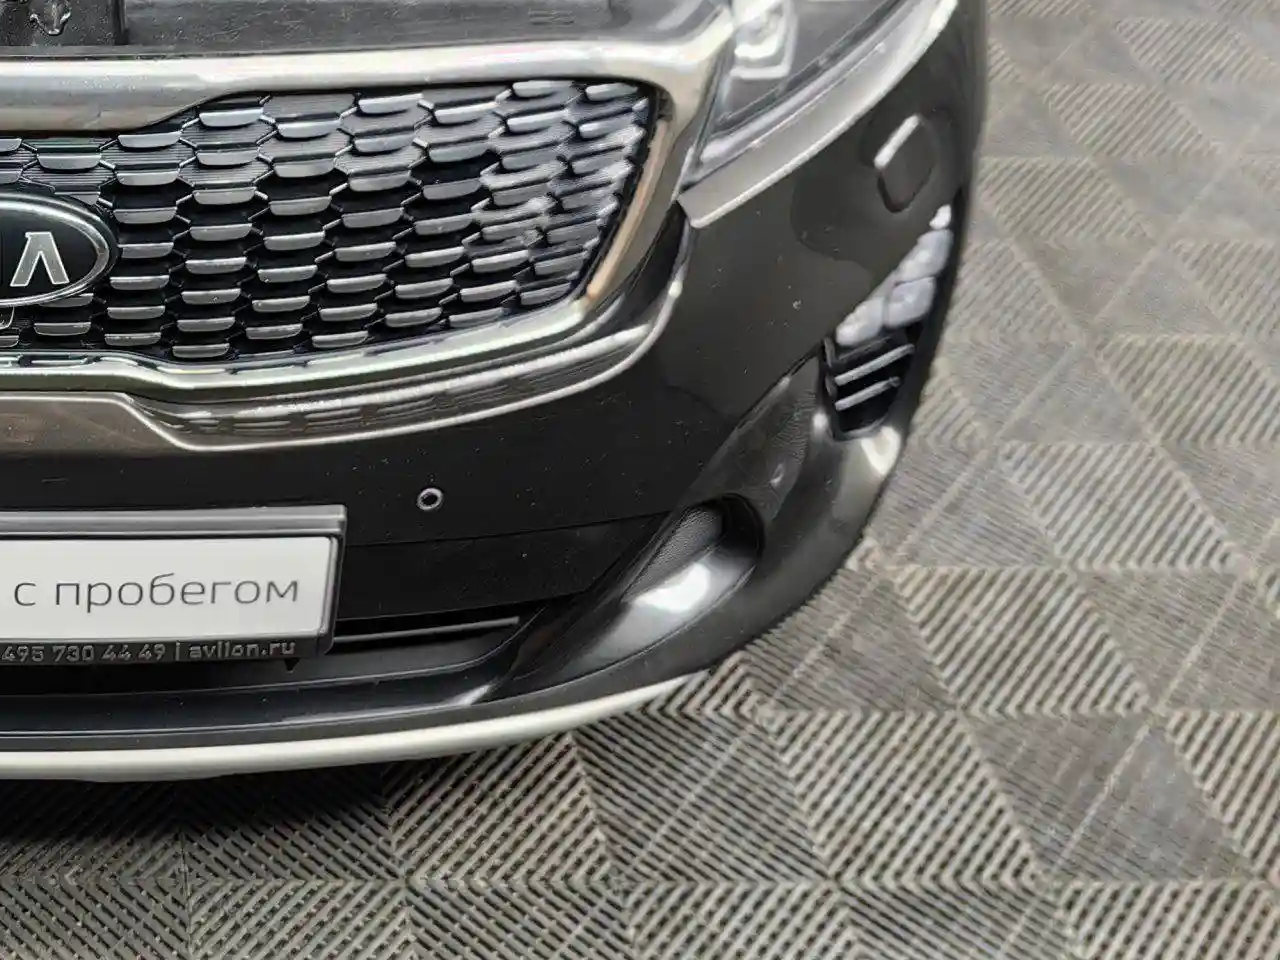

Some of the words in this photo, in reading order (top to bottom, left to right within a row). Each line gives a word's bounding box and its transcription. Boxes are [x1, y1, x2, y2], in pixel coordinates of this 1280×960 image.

[14, 581, 37, 607] с
[55, 572, 300, 614] пробегом
[1, 645, 45, 663] 495
[52, 644, 95, 663] 730
[101, 644, 132, 661] 44
[137, 642, 166, 660] 49
[189, 640, 297, 658] avilon.ru
